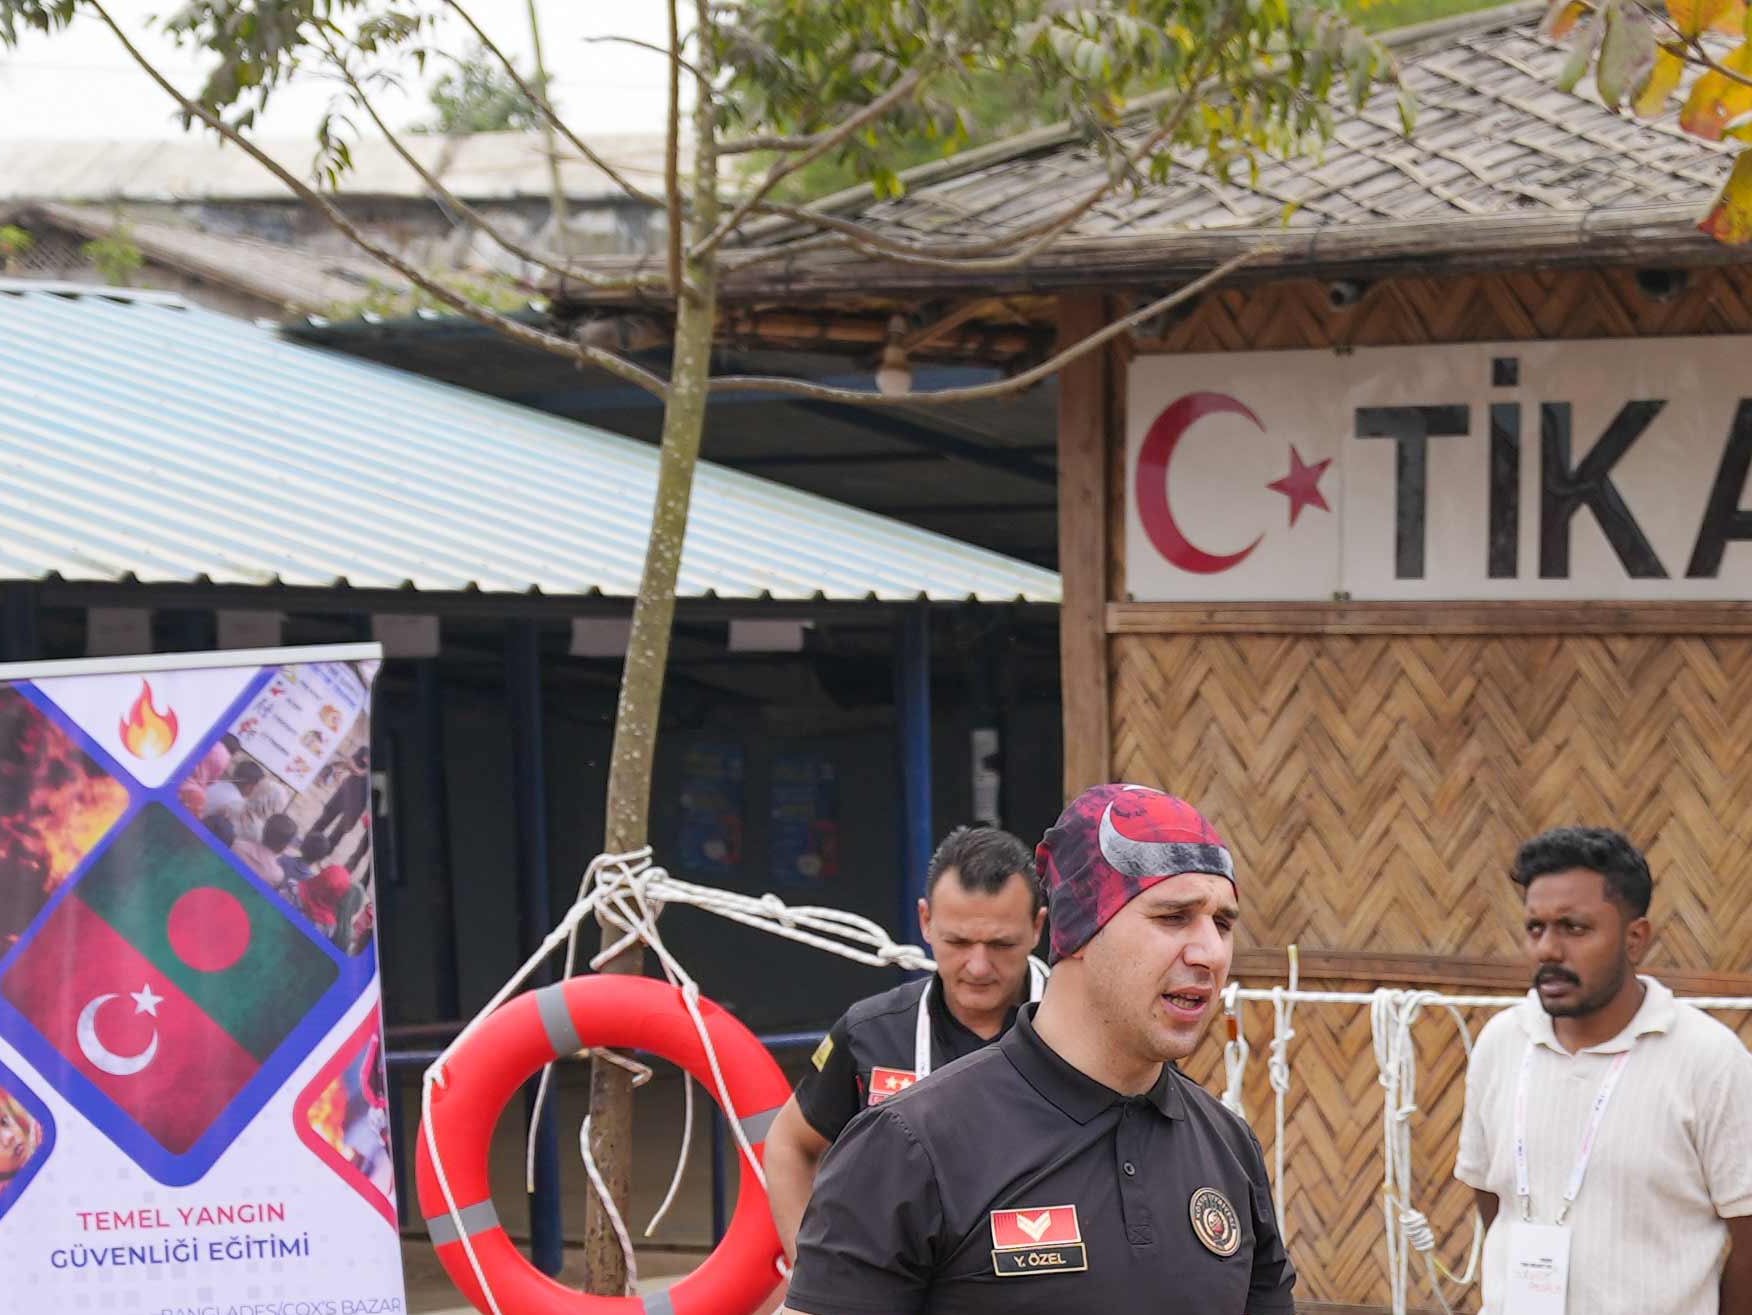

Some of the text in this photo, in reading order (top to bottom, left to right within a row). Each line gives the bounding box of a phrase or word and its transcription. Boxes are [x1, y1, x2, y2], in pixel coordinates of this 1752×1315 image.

[76, 1203, 286, 1232] TEMEL YANGIN
[50, 1232, 310, 1269] GÜVENLİĞİ EĞİTİMİ
[1028, 1252, 1066, 1267] ÖZEL
[341, 1297, 401, 1315] BAZAR
